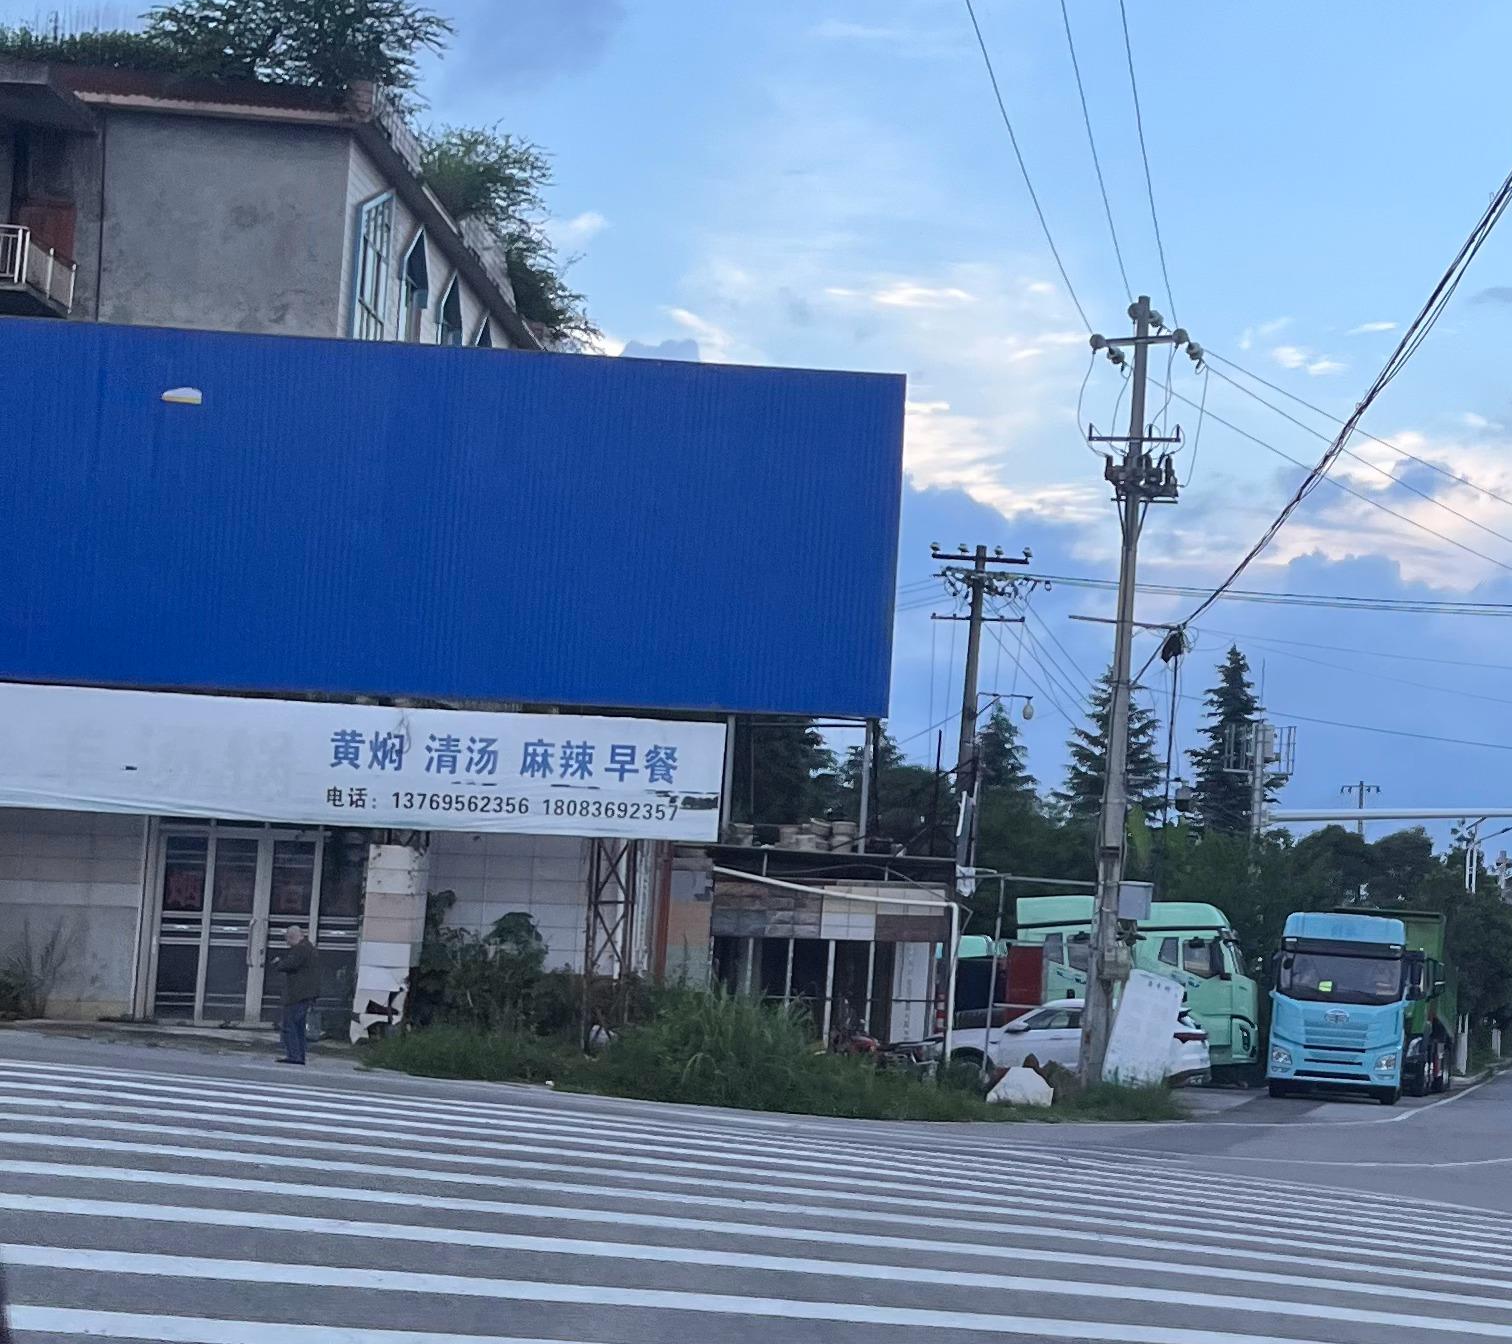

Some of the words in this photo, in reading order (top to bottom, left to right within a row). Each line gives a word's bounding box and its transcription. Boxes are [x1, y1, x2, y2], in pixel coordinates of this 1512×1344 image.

[329, 729, 403, 771] 黄焖
[424, 733, 499, 775] 清汤
[392, 792, 529, 815] 13769562356
[543, 799, 679, 822] 18083692357
